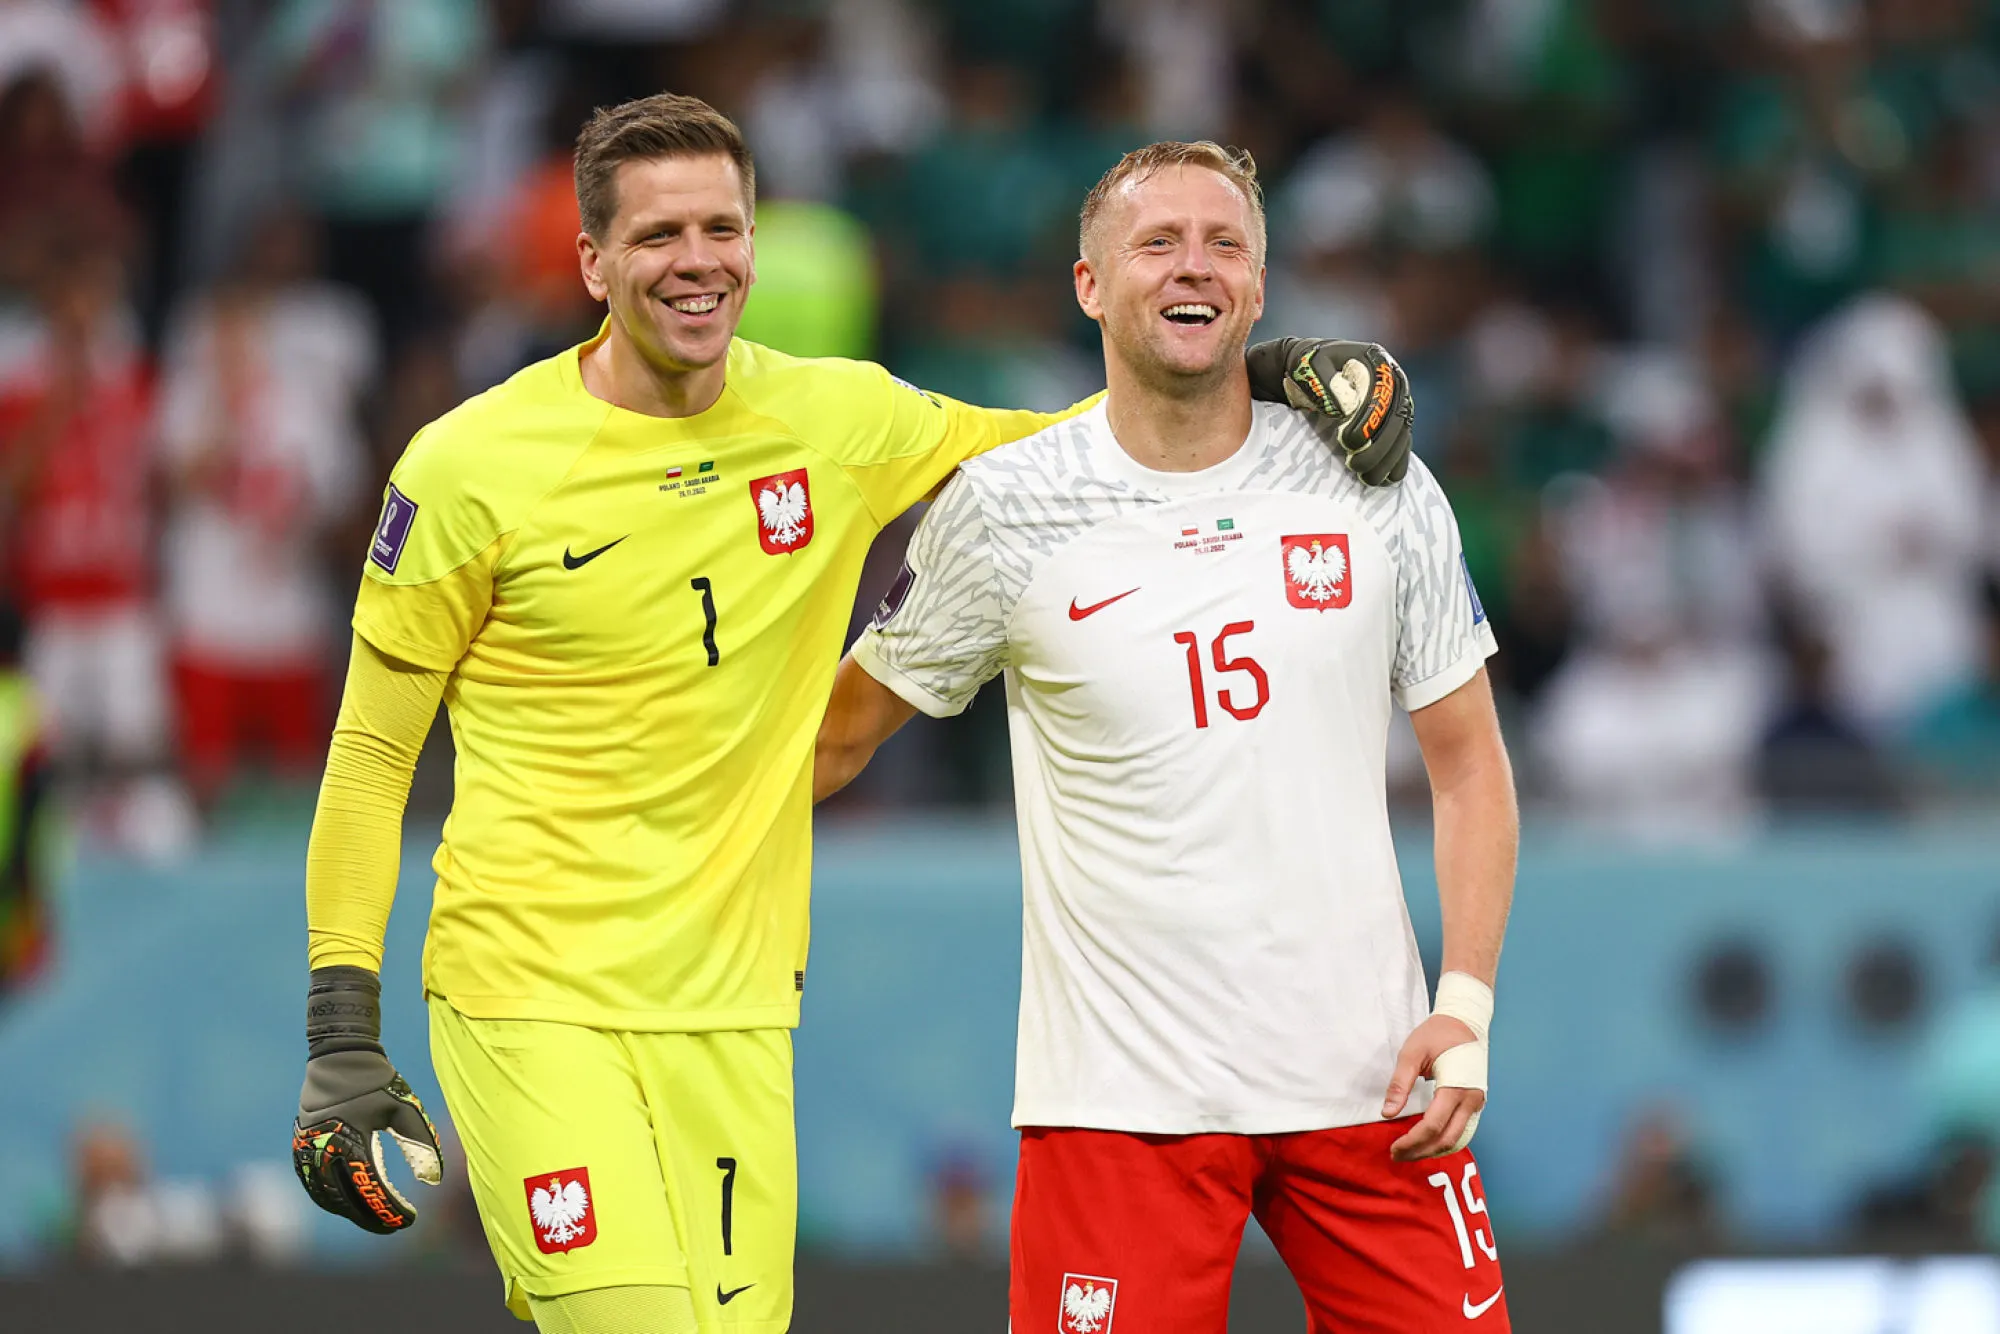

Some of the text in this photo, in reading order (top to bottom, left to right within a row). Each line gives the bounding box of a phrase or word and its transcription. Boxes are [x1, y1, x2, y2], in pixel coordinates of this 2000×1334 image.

[1362, 363, 1395, 439] reusch
[658, 483, 681, 491] POLAND
[684, 478, 700, 487] SAUDI
[702, 475, 720, 484] ARABIA
[1174, 540, 1198, 549] POLAND
[1203, 536, 1220, 544] SAUDI
[1221, 533, 1243, 541] ARABIA
[691, 577, 719, 666] 1
[1173, 620, 1269, 728] 15
[348, 1161, 404, 1227] reusch
[716, 1157, 736, 1256] 1
[1428, 1162, 1497, 1269] 15
